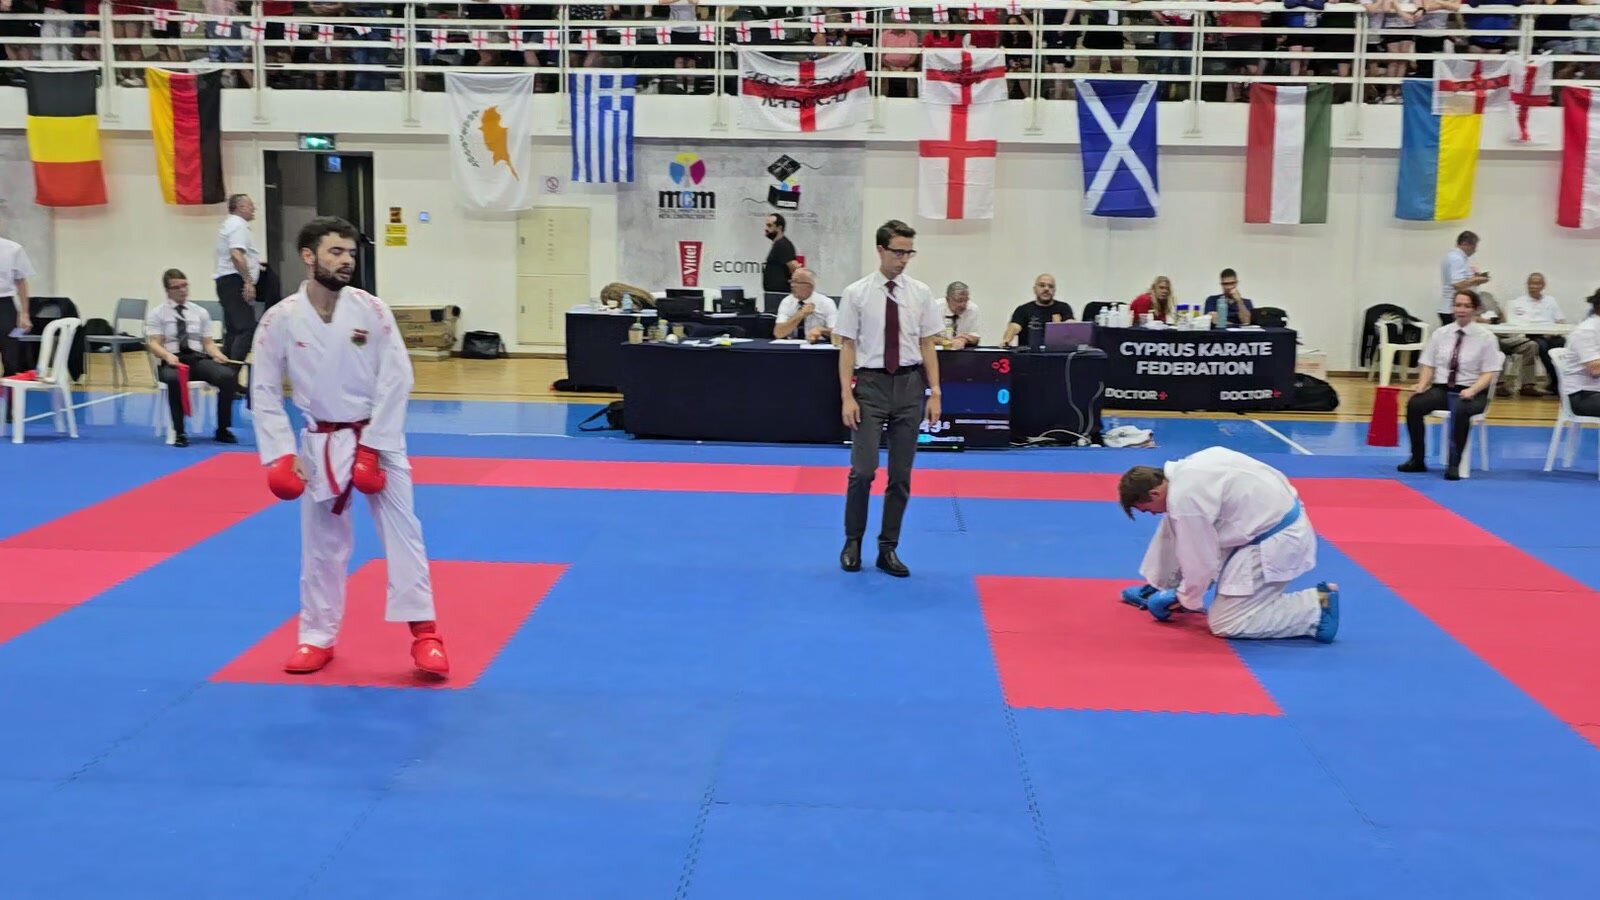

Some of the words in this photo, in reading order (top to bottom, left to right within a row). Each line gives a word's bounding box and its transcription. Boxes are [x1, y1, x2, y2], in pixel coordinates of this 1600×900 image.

[1120, 342, 1195, 356] CYPRUS
[1198, 342, 1272, 356] KARATE
[1136, 361, 1254, 375] FEDERATION
[997, 388, 1010, 404] 0
